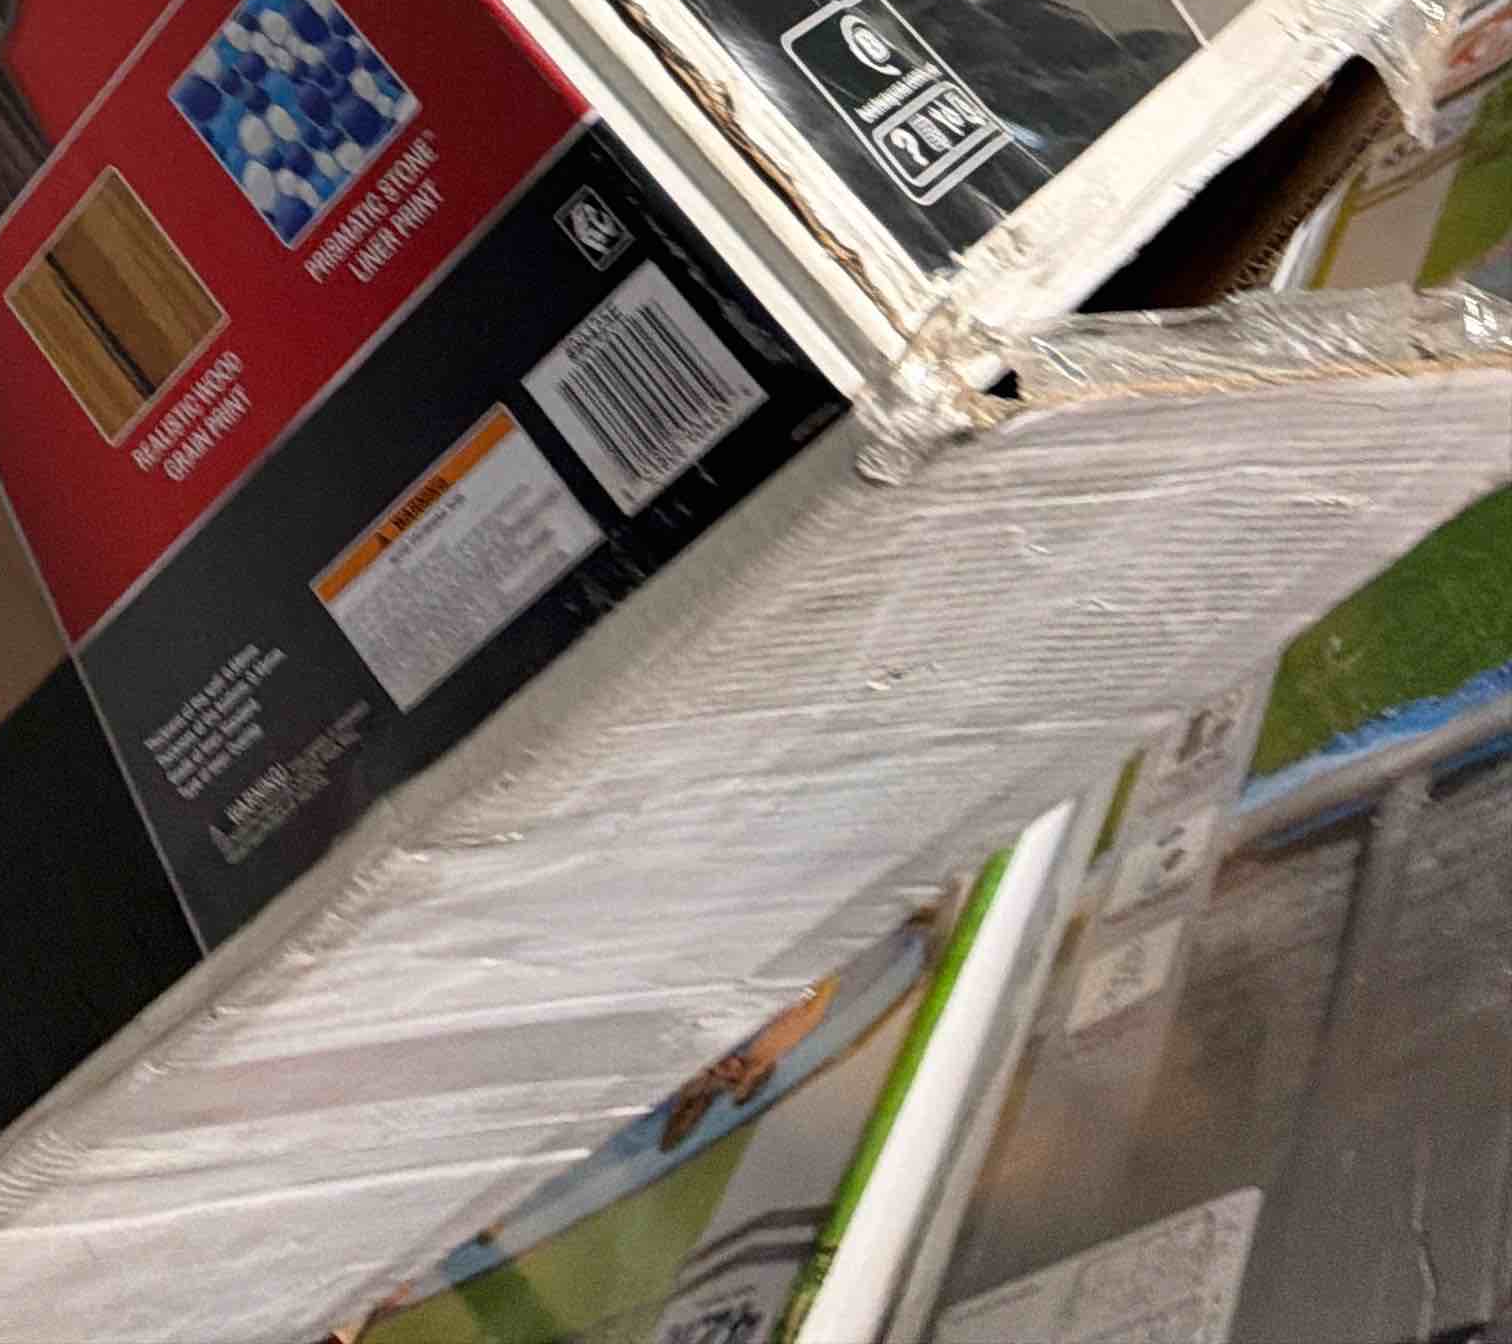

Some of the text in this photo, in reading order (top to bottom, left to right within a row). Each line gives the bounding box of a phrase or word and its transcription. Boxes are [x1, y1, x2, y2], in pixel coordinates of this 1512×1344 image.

[302, 187, 389, 285] PRISMATIC
[347, 175, 447, 285] LINER PRINT
[161, 381, 254, 485] GRAIN PRINT
